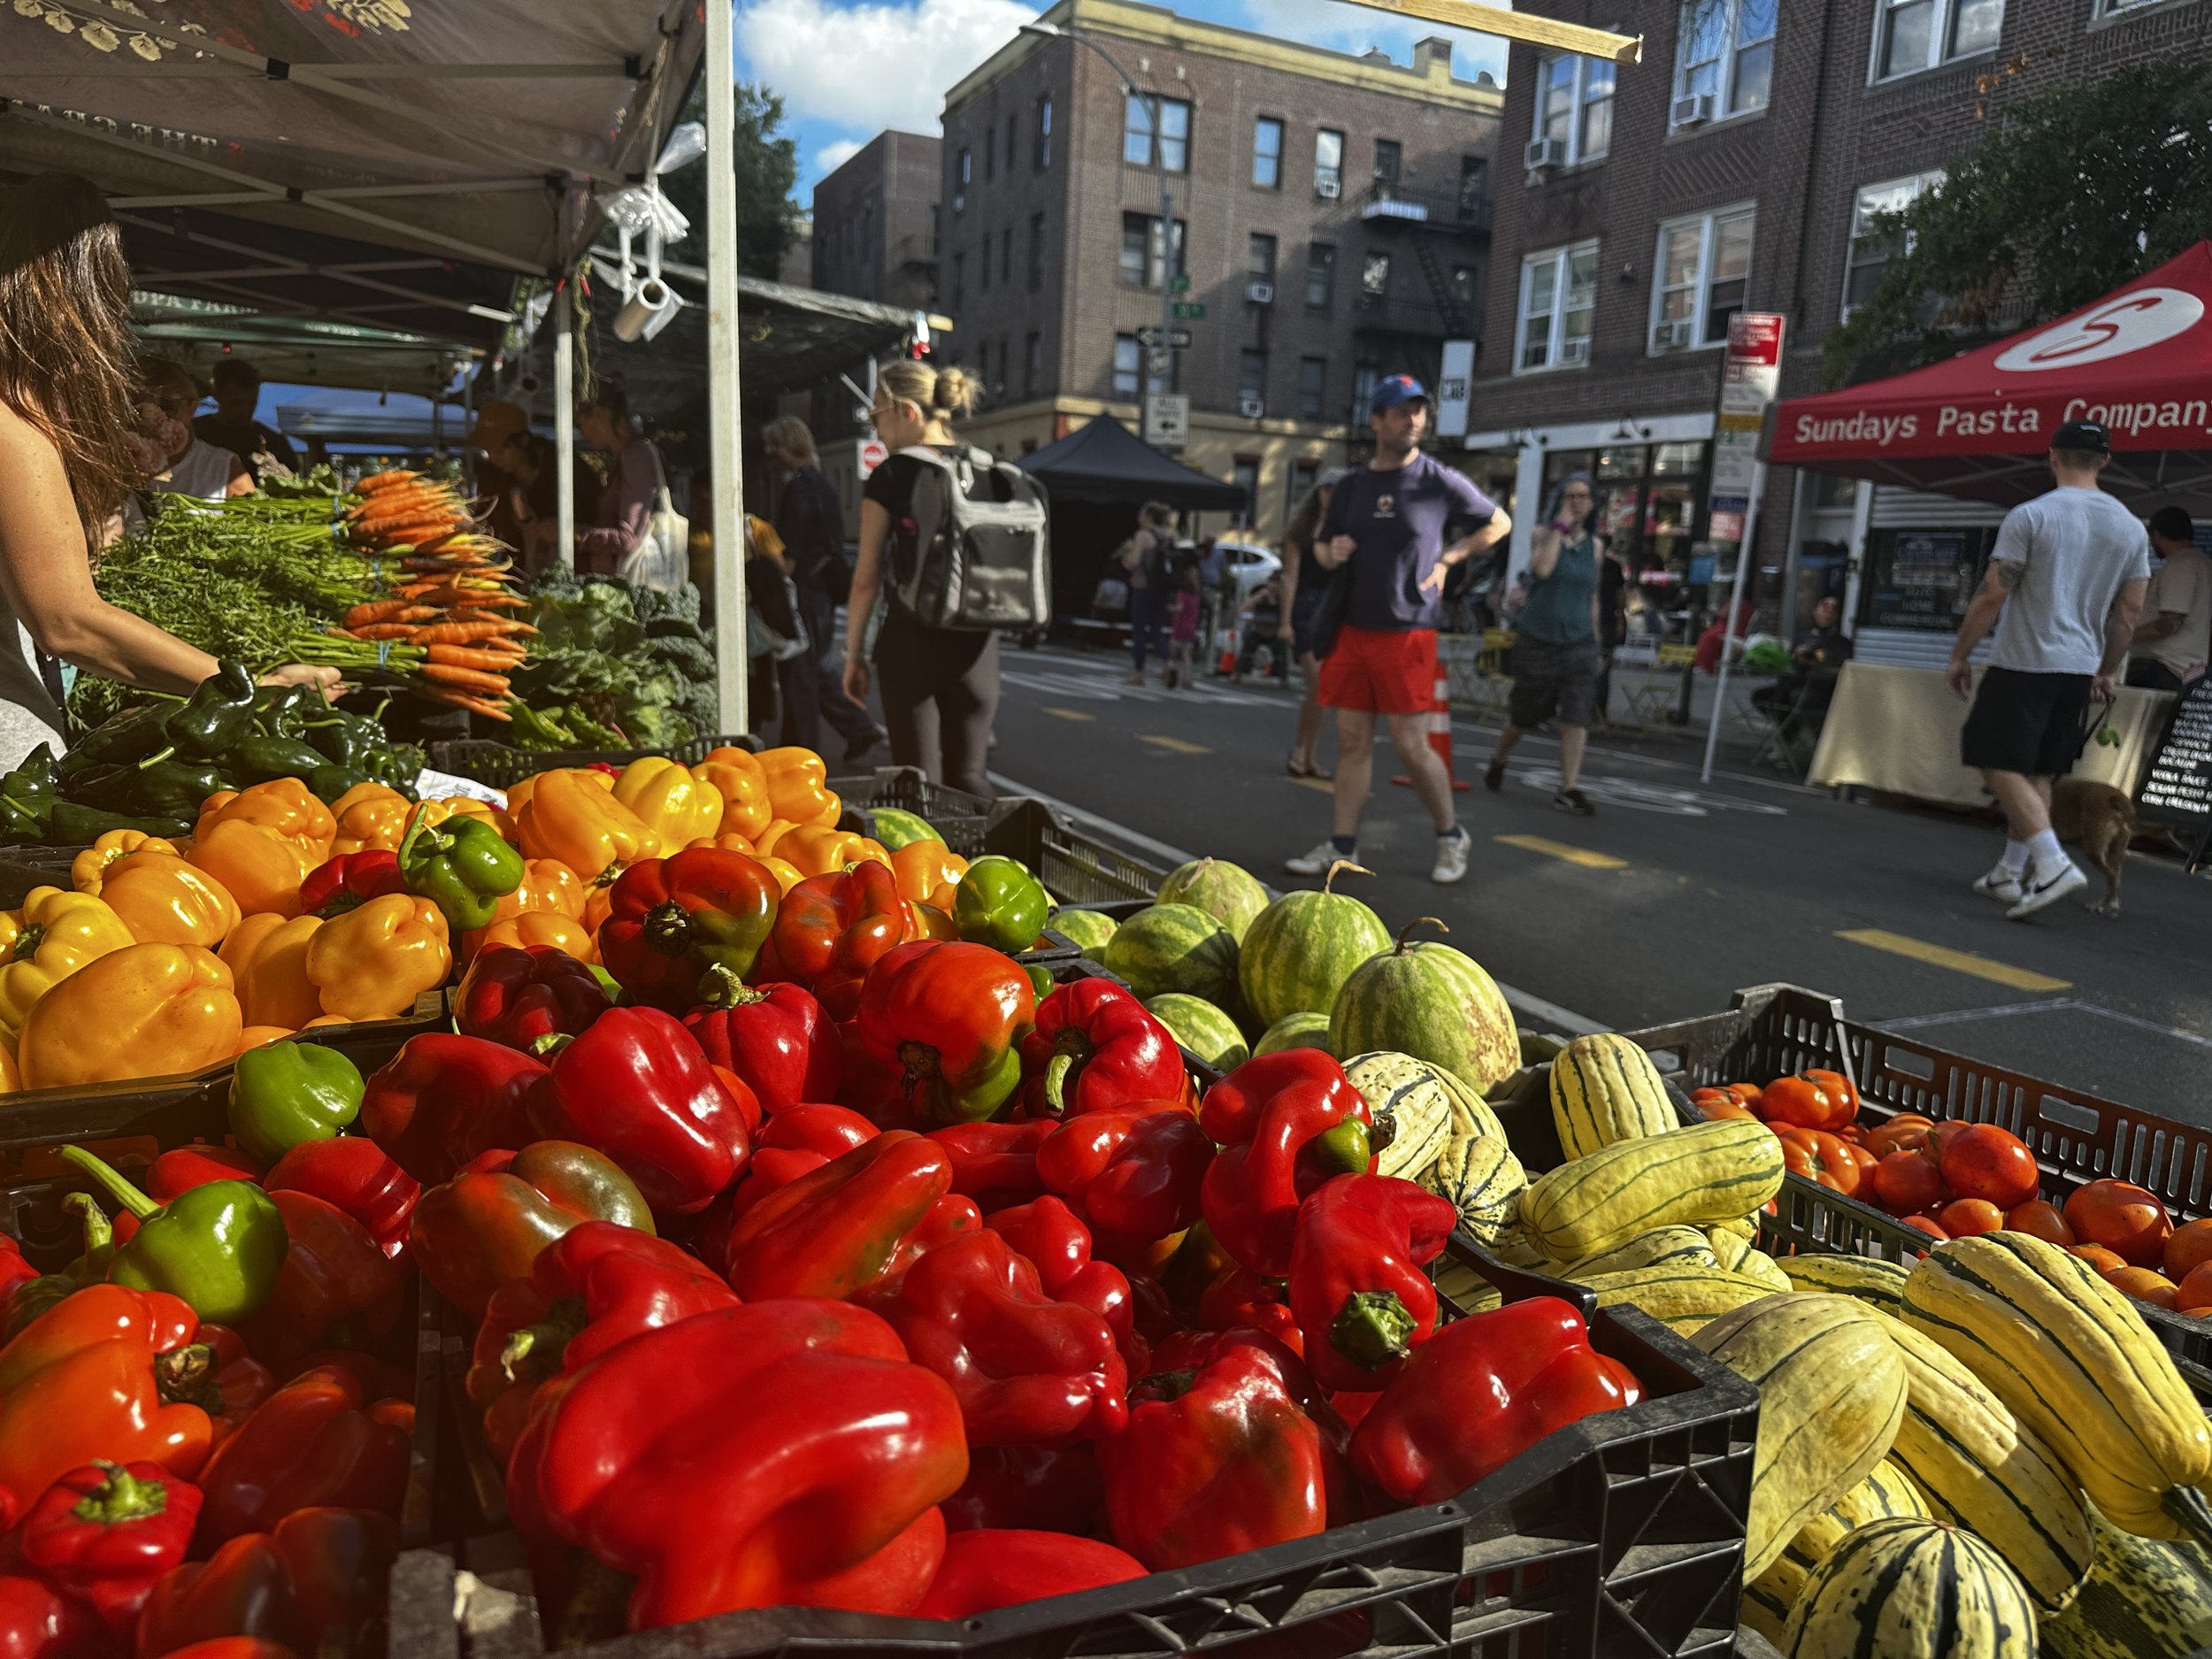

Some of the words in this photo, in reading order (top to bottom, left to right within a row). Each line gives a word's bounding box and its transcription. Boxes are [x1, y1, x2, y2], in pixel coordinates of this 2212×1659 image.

[1795, 410, 1918, 446] Sundays
[1936, 401, 2039, 437] Pasta
[2063, 398, 2212, 436] Compan
